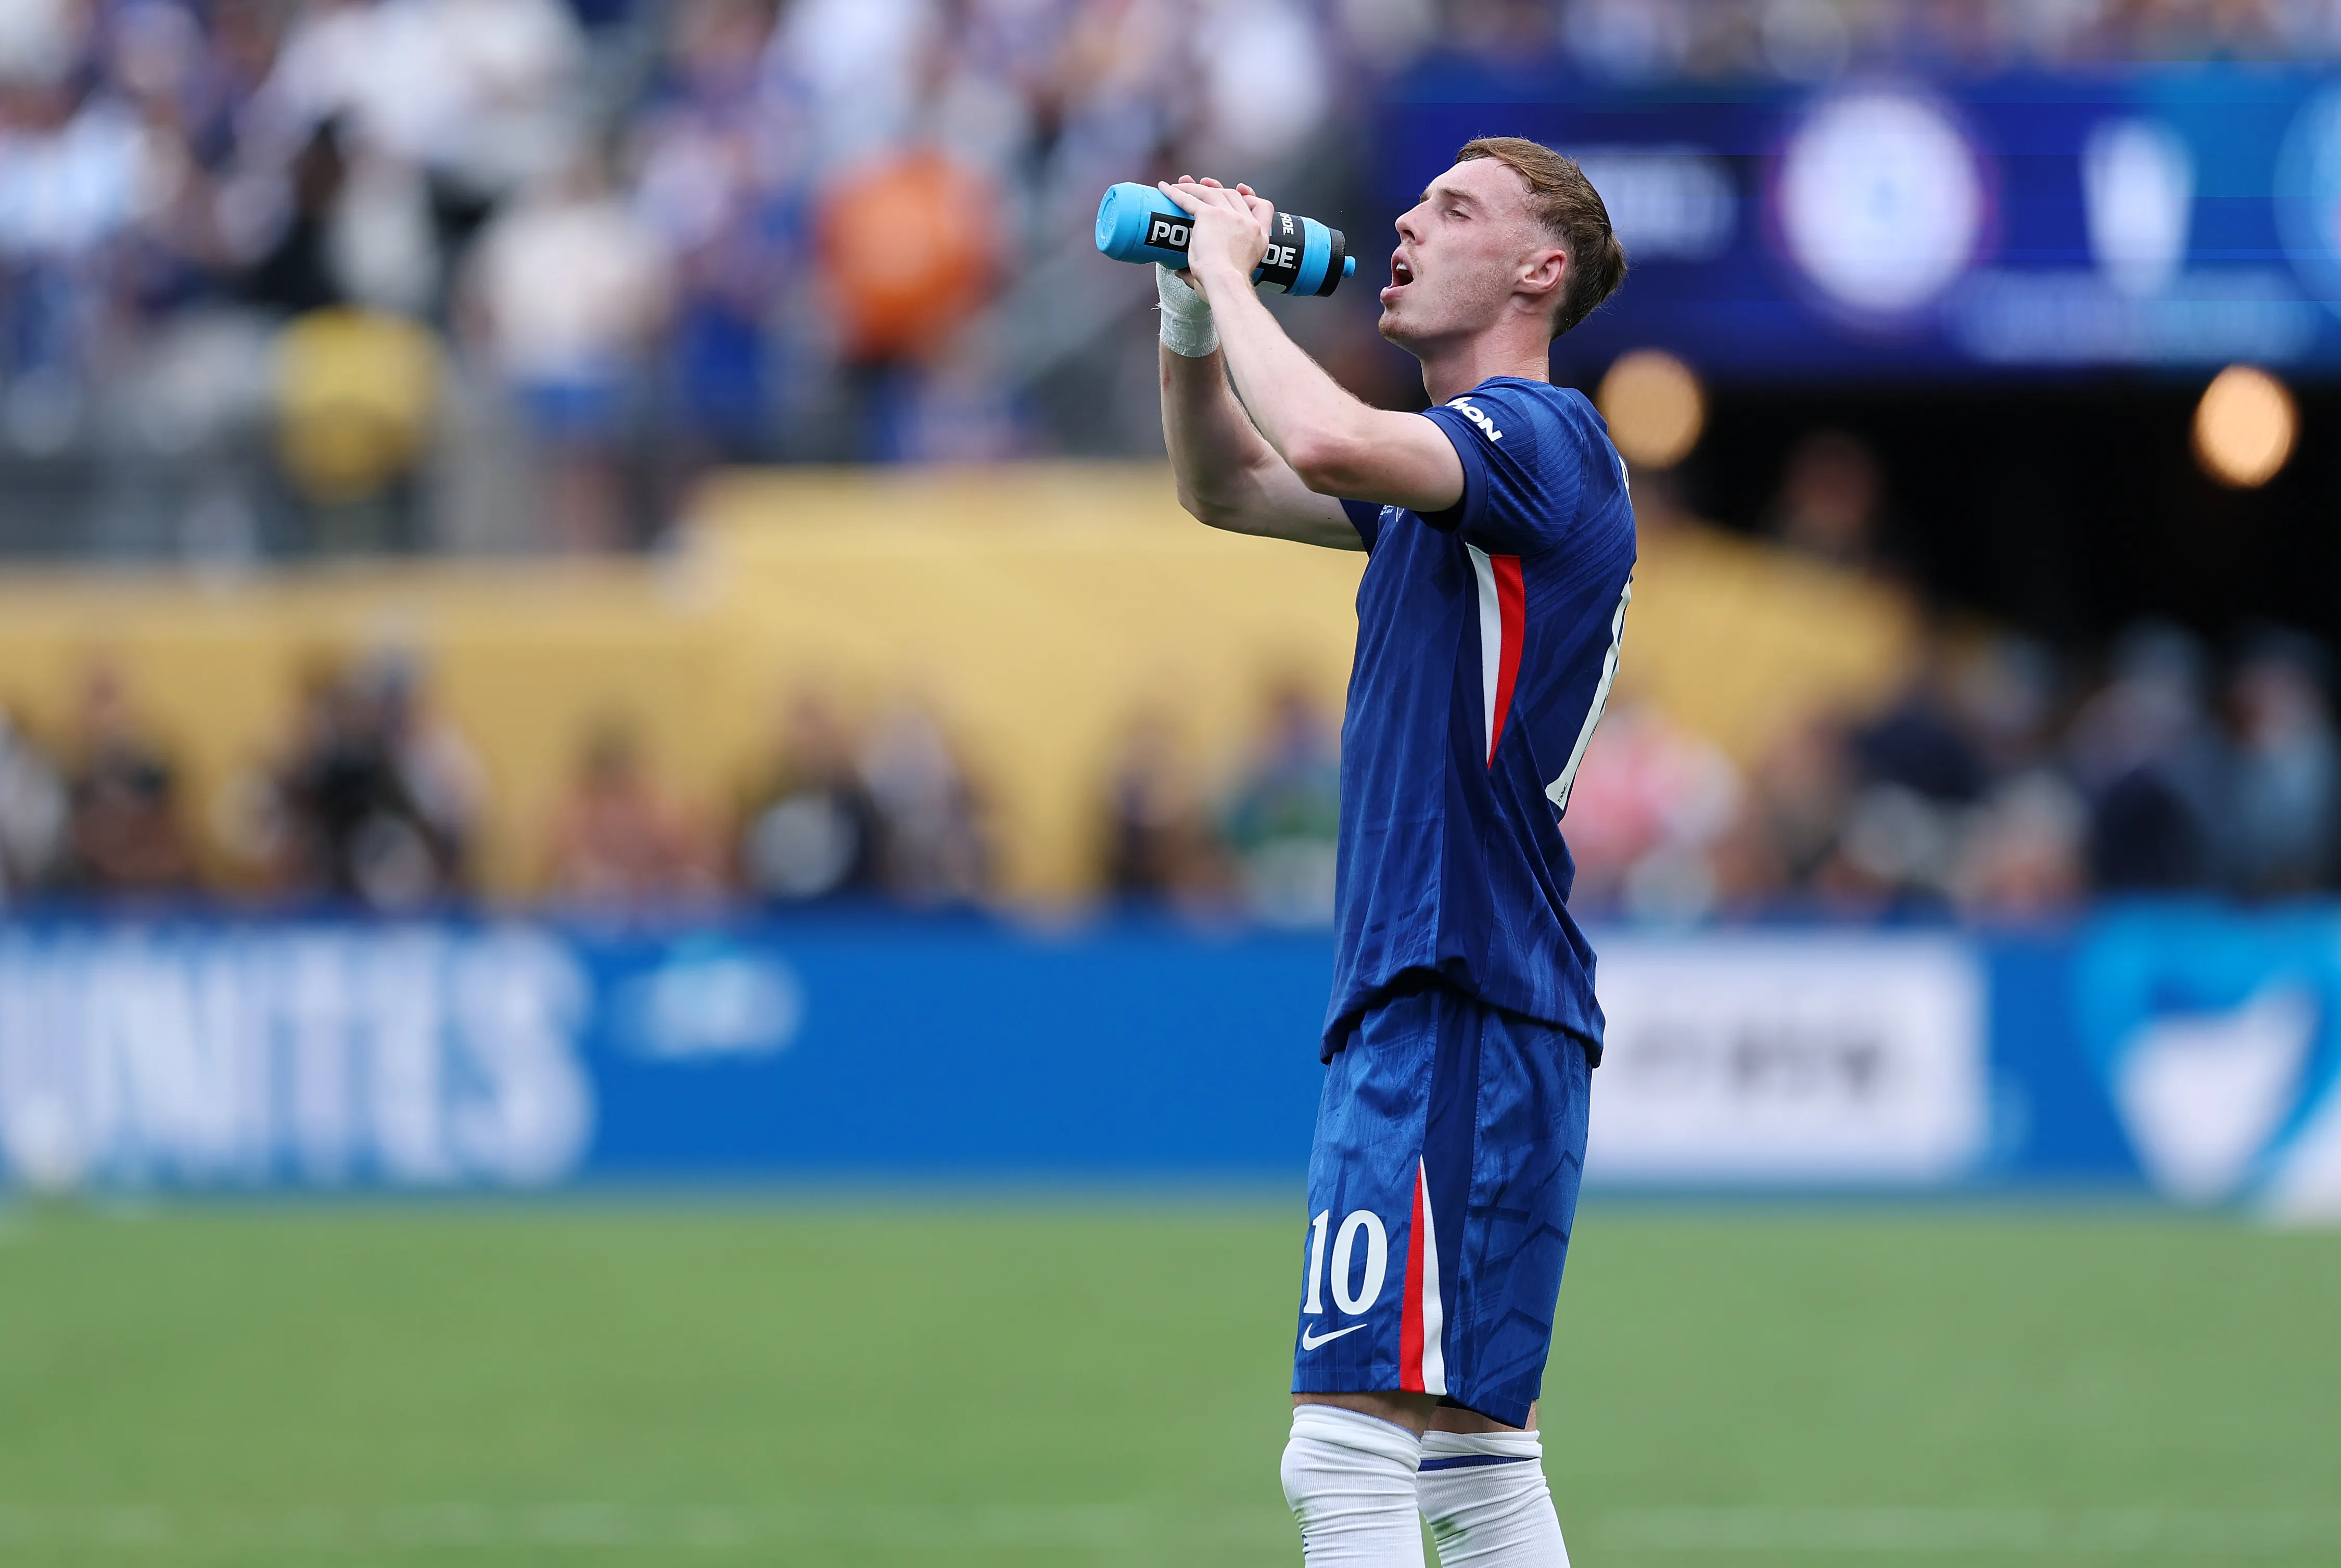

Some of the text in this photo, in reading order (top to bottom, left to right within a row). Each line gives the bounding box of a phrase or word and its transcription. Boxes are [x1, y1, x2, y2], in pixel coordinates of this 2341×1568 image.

[1151, 220, 1296, 269] PODE
[1444, 397, 1503, 442] ION
[1303, 1209, 1388, 1315] 10
